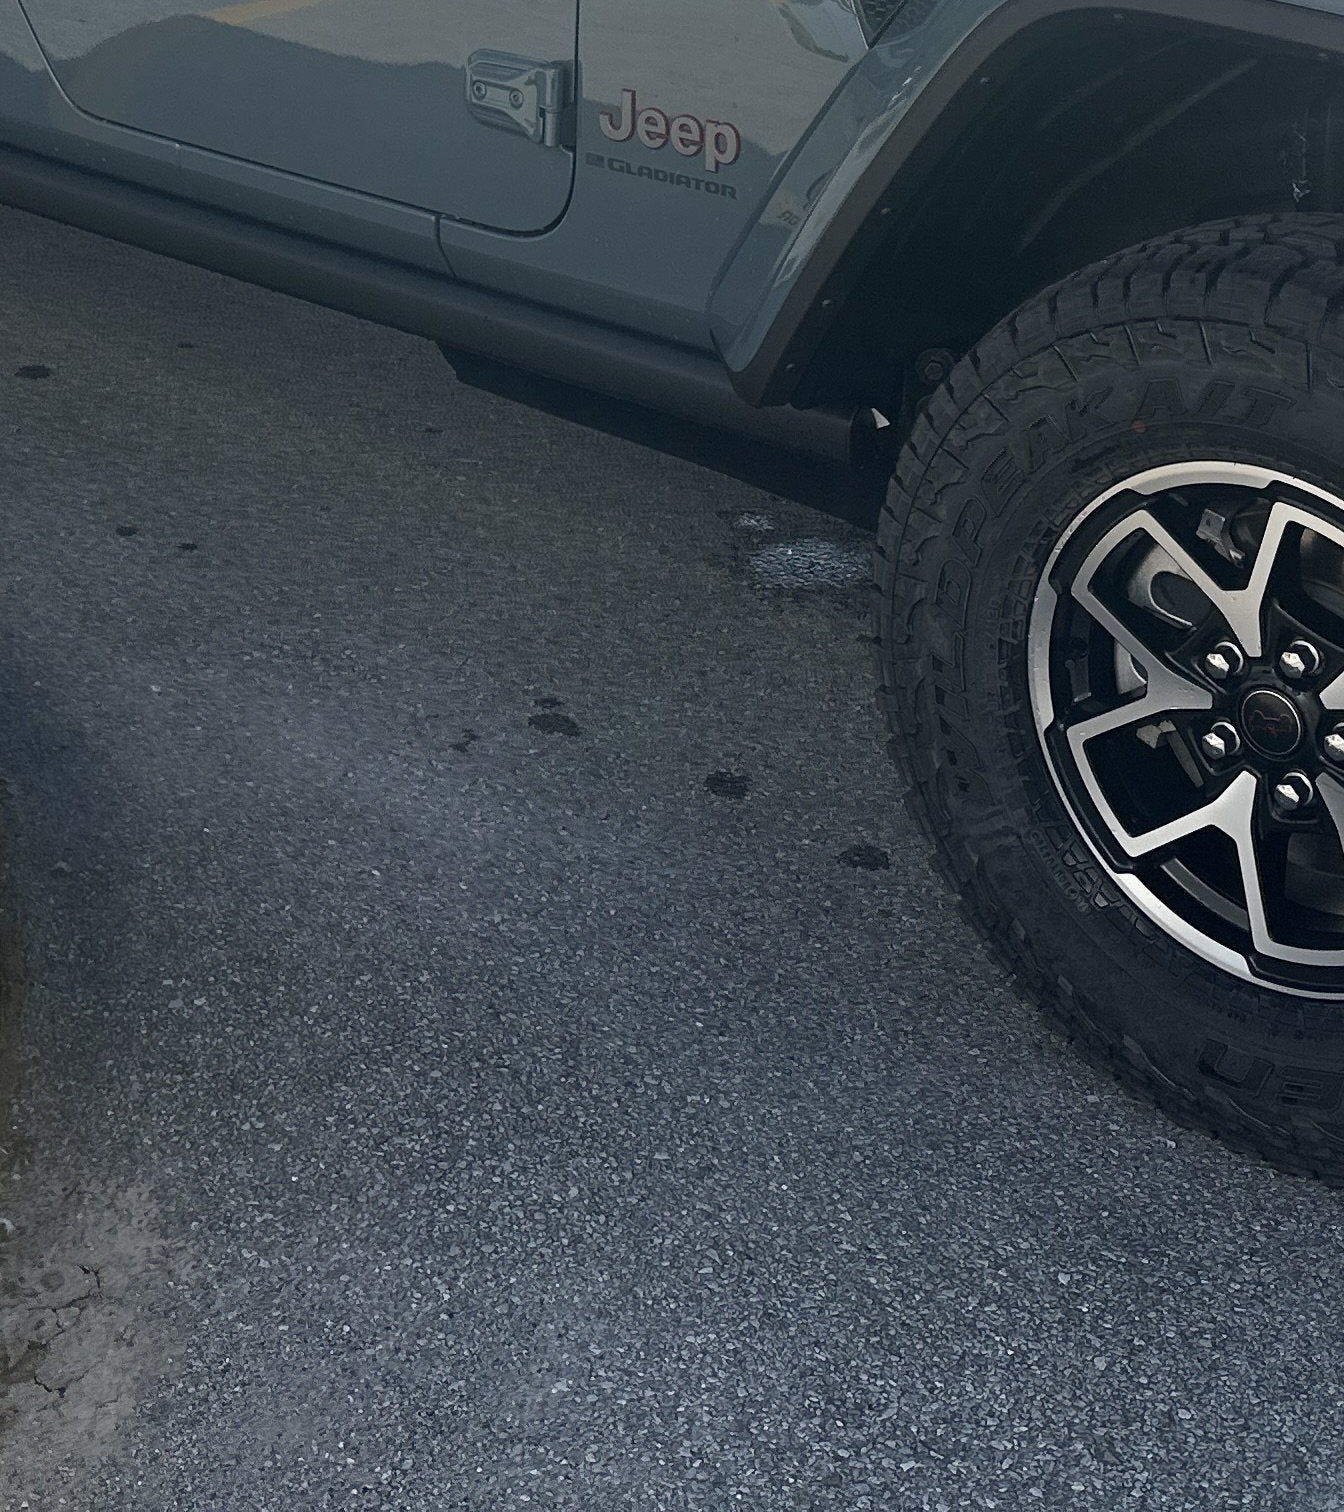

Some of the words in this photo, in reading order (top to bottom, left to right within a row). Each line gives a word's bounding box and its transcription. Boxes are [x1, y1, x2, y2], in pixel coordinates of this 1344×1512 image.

[599, 88, 741, 174] Jeep
[607, 157, 738, 201] GLADIATOR
[928, 380, 1118, 808] WILDPEAK
